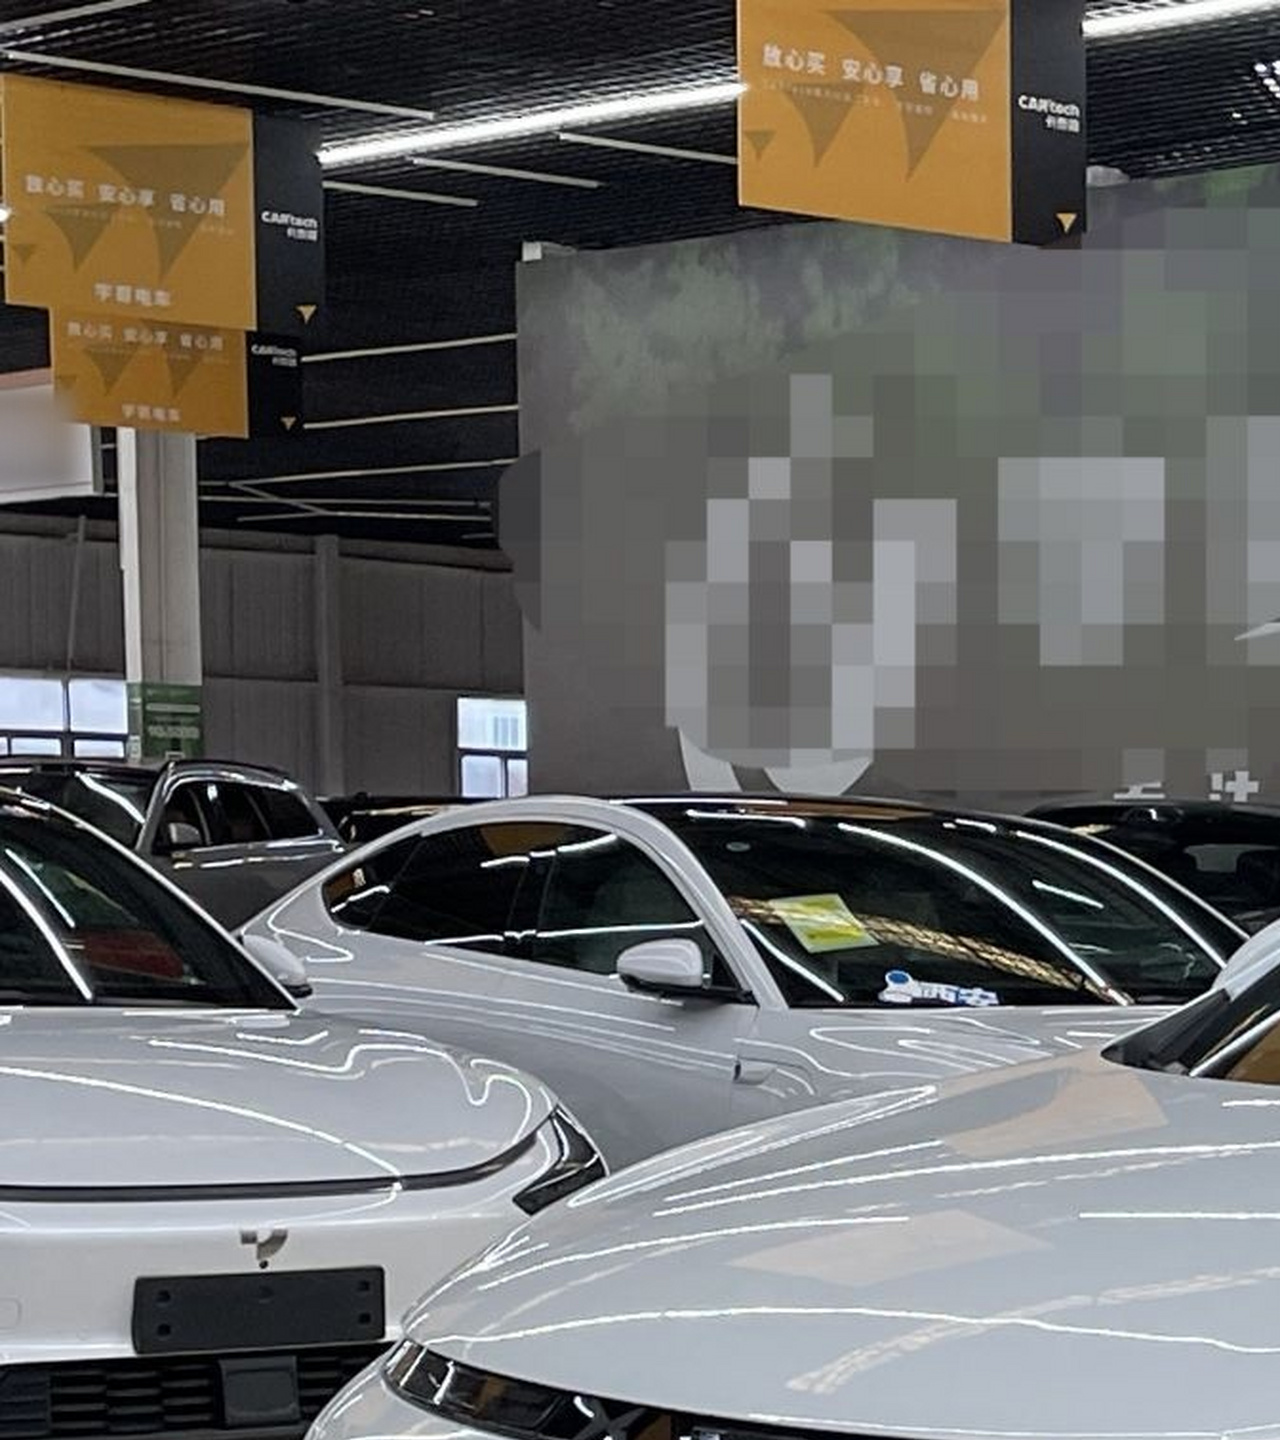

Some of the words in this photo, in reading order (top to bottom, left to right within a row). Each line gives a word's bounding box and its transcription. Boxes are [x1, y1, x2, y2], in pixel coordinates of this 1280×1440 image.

[762, 43, 826, 76] 放心买
[841, 58, 903, 88] 安心享
[919, 71, 979, 101] 省心用
